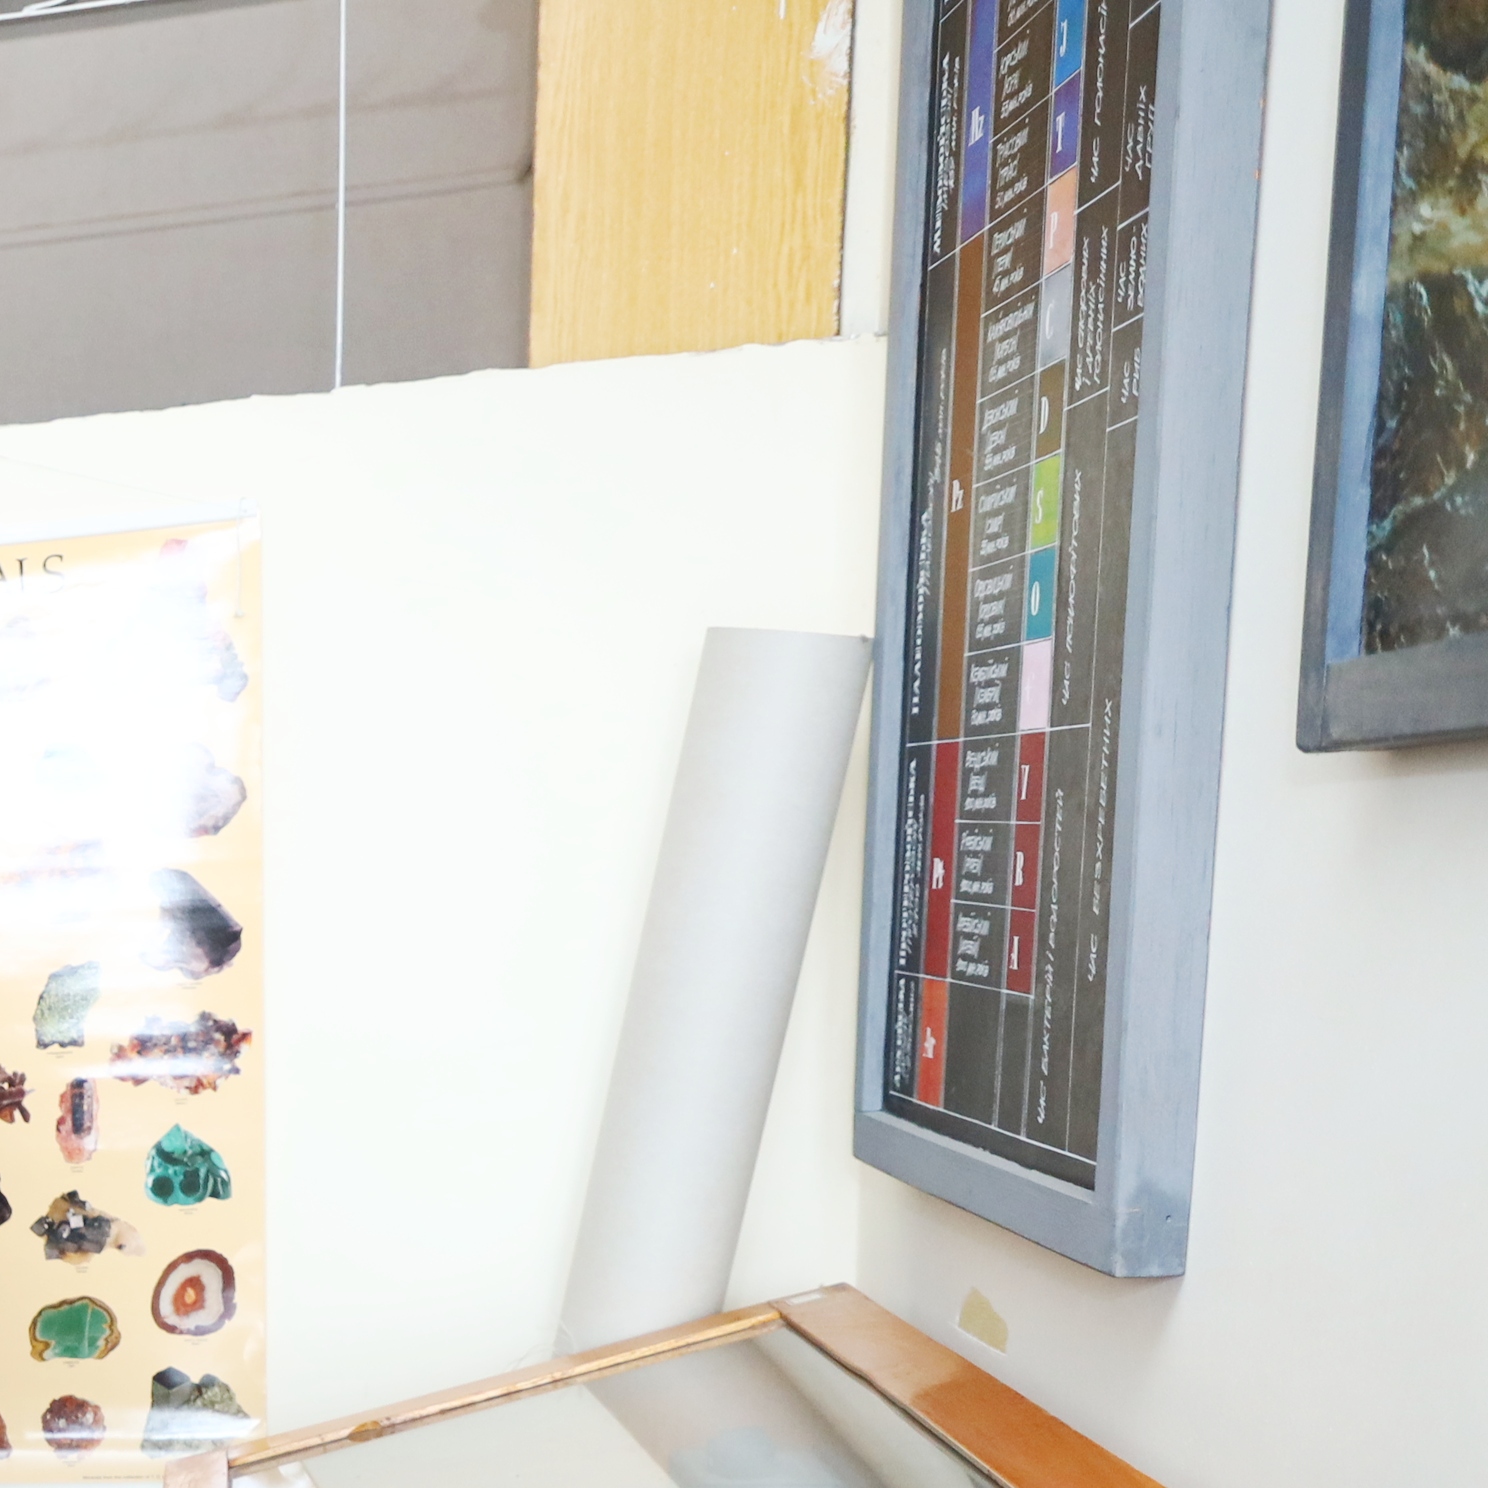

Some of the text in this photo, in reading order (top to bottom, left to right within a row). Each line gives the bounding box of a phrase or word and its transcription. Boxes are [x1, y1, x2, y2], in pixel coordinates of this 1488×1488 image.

[1124, 122, 1134, 172] ЧАС
[1050, 211, 1059, 250] P
[1117, 261, 1127, 303] ЧАС
[1074, 353, 1084, 391] ЧАС
[1120, 360, 1130, 404] ЧАС
[1039, 396, 1049, 435] D
[1035, 488, 1044, 525] S
[1087, 933, 1099, 982] ЧАС
[1036, 1080, 1047, 1125] ЧАС
